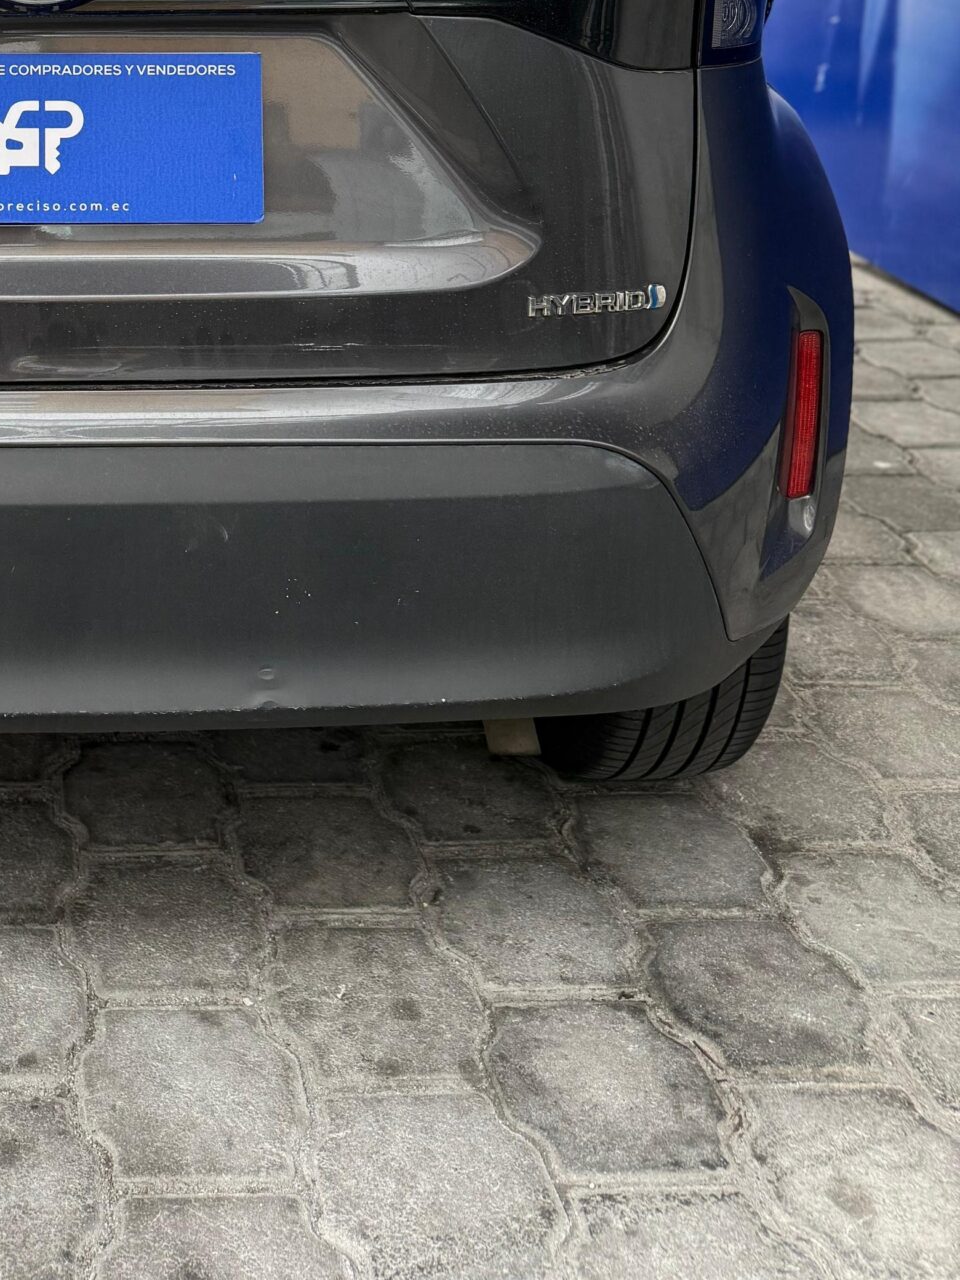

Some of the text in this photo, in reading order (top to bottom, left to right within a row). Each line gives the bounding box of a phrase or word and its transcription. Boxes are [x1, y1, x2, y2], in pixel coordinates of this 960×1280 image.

[9, 64, 122, 76] COMPRADORES
[124, 64, 135, 76] Y
[137, 64, 236, 76] VENDEDORES
[528, 290, 646, 318] HYBRID
